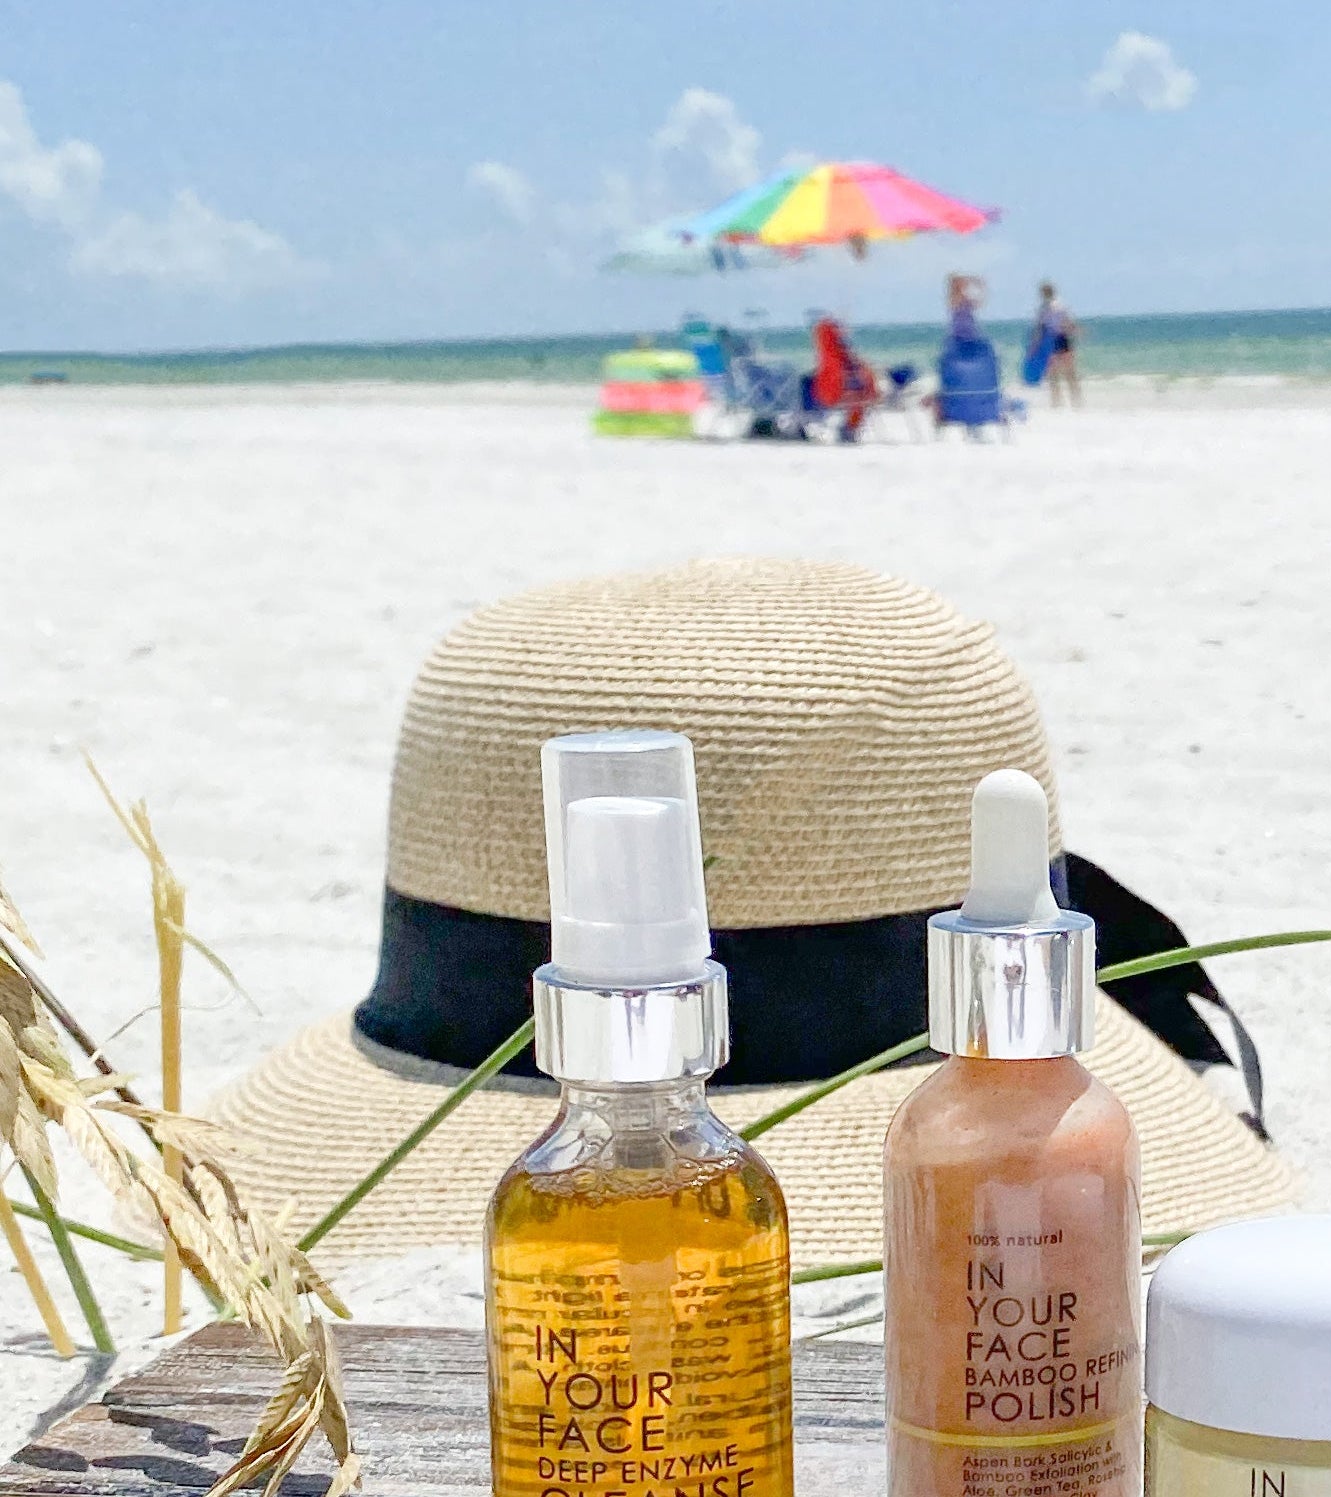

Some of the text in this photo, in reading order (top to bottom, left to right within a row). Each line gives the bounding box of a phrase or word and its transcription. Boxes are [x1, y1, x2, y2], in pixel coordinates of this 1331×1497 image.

[967, 1230, 1063, 1247] 100% natural
[966, 1260, 1005, 1291] IN
[966, 1292, 1078, 1327] YOUR
[535, 1324, 577, 1364] IN
[966, 1328, 1071, 1362] FACE
[536, 1368, 674, 1411] YOUR
[965, 1362, 1078, 1387] BAMBOO
[965, 1381, 1100, 1423] POLISH
[538, 1413, 666, 1454] FACE
[538, 1456, 608, 1484] DEEP
[621, 1443, 738, 1484] ENZYME
[962, 1456, 1009, 1469] Aspen
[1014, 1453, 1046, 1468] Bark
[962, 1469, 1025, 1482] Bamboo
[1030, 1462, 1100, 1482] Exfoliation
[1006, 1484, 1052, 1497] Green
[1250, 1467, 1285, 1497] IN
